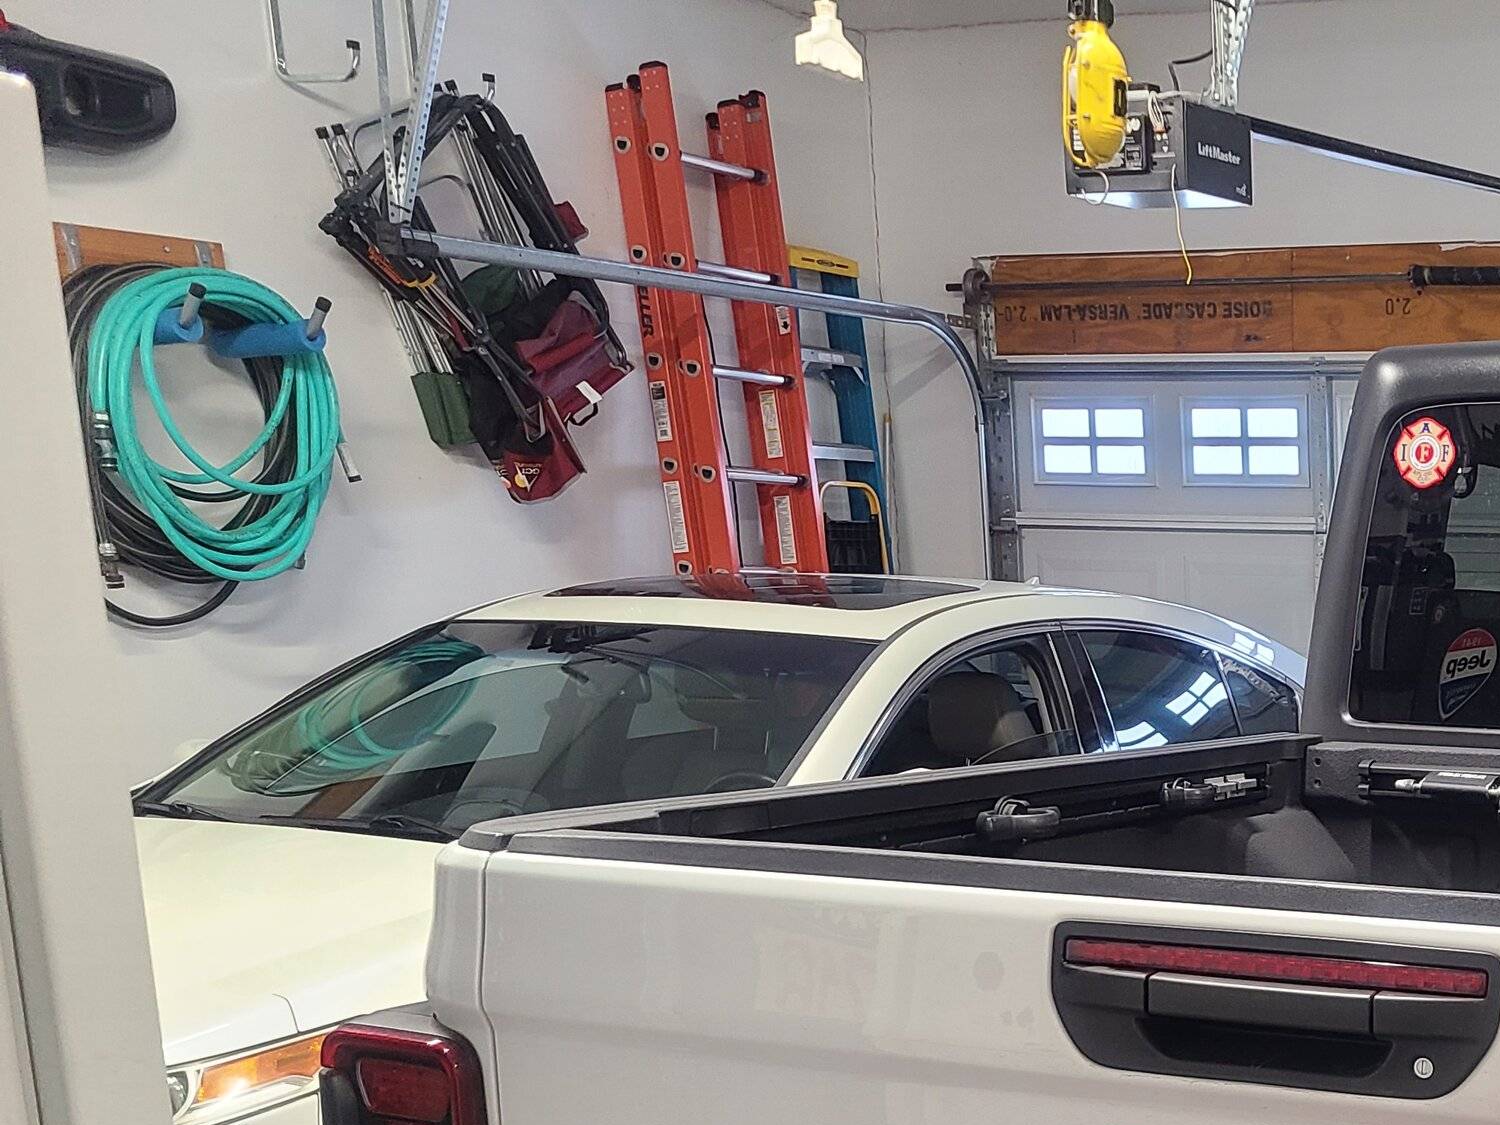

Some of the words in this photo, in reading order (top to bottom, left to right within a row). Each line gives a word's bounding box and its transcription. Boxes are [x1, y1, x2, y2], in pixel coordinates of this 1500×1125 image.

[1197, 141, 1242, 167] LiftMaster
[638, 285, 656, 339] ELLER
[1040, 302, 1129, 322] VERSA-LAM
[1141, 302, 1218, 321] CASCADE
[1385, 297, 1411, 316] 2.0
[1419, 422, 1432, 434] A
[1400, 443, 1408, 462] I
[1419, 442, 1431, 464] F
[1440, 444, 1450, 462] F
